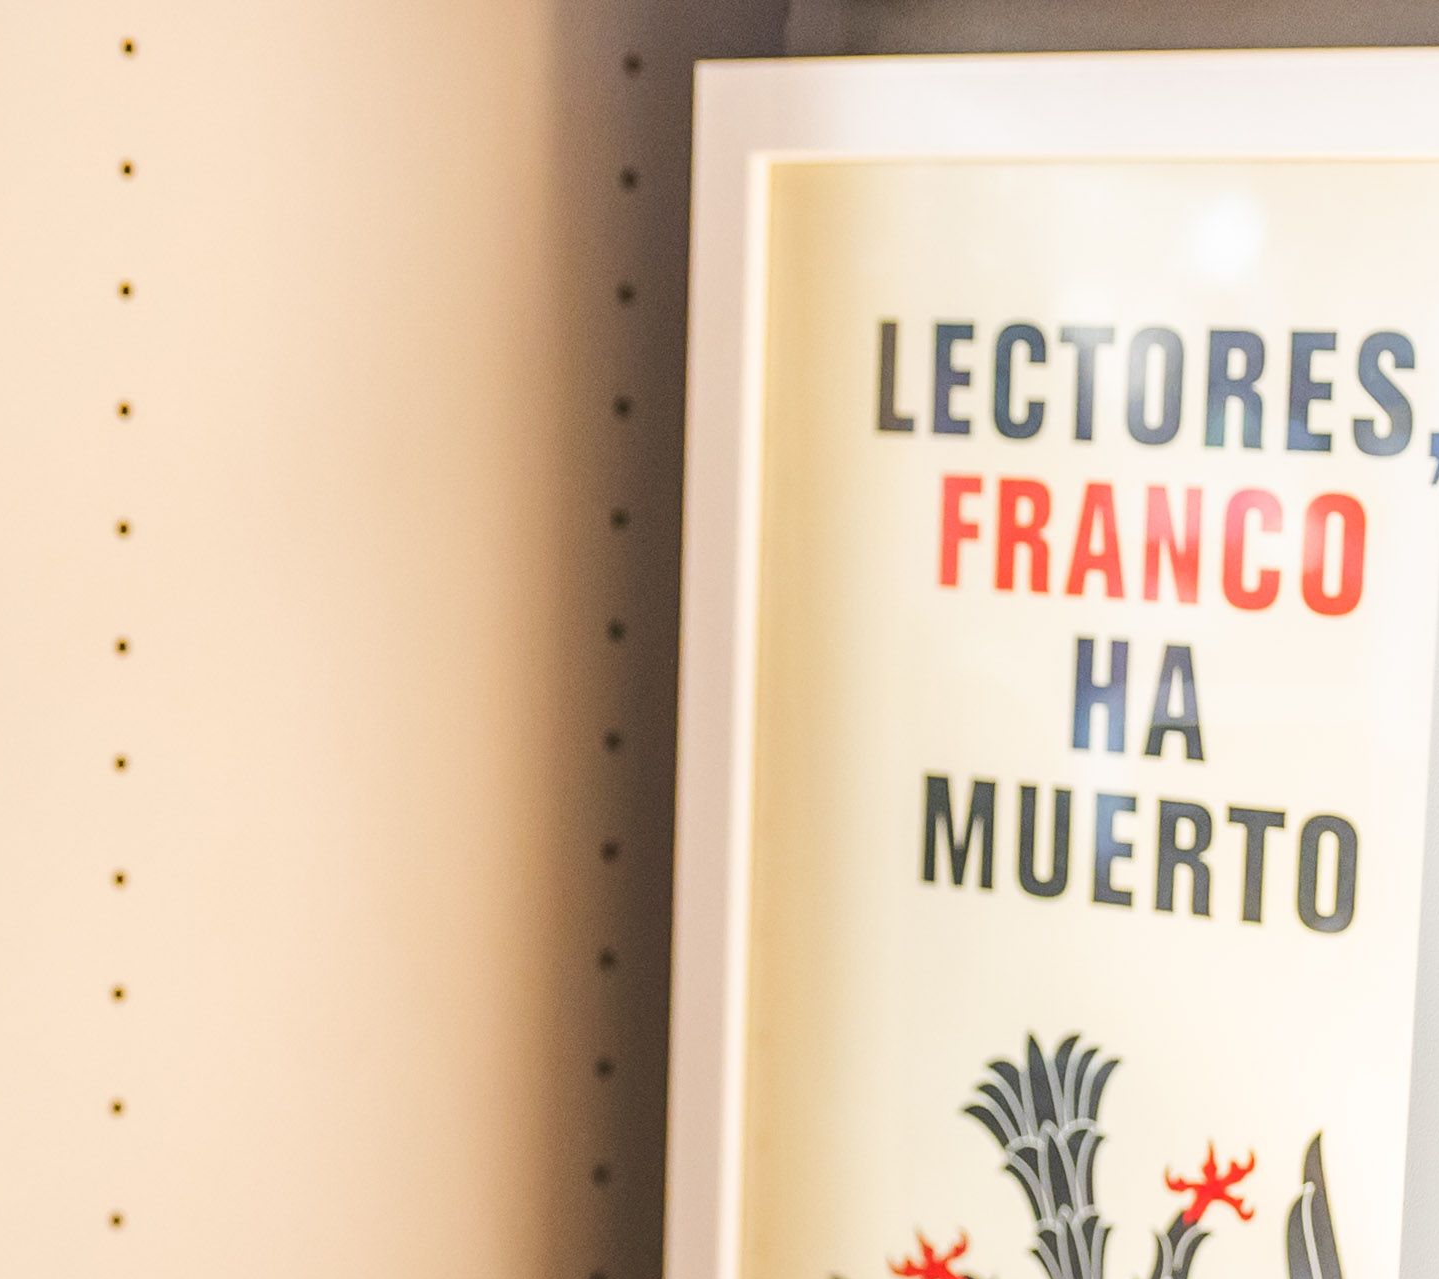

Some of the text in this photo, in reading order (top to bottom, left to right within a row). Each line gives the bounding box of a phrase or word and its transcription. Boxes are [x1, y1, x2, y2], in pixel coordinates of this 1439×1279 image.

[937, 473, 1369, 617] FRANCO
[1070, 637, 1207, 763] HA
[920, 775, 1360, 935] MUERTO
